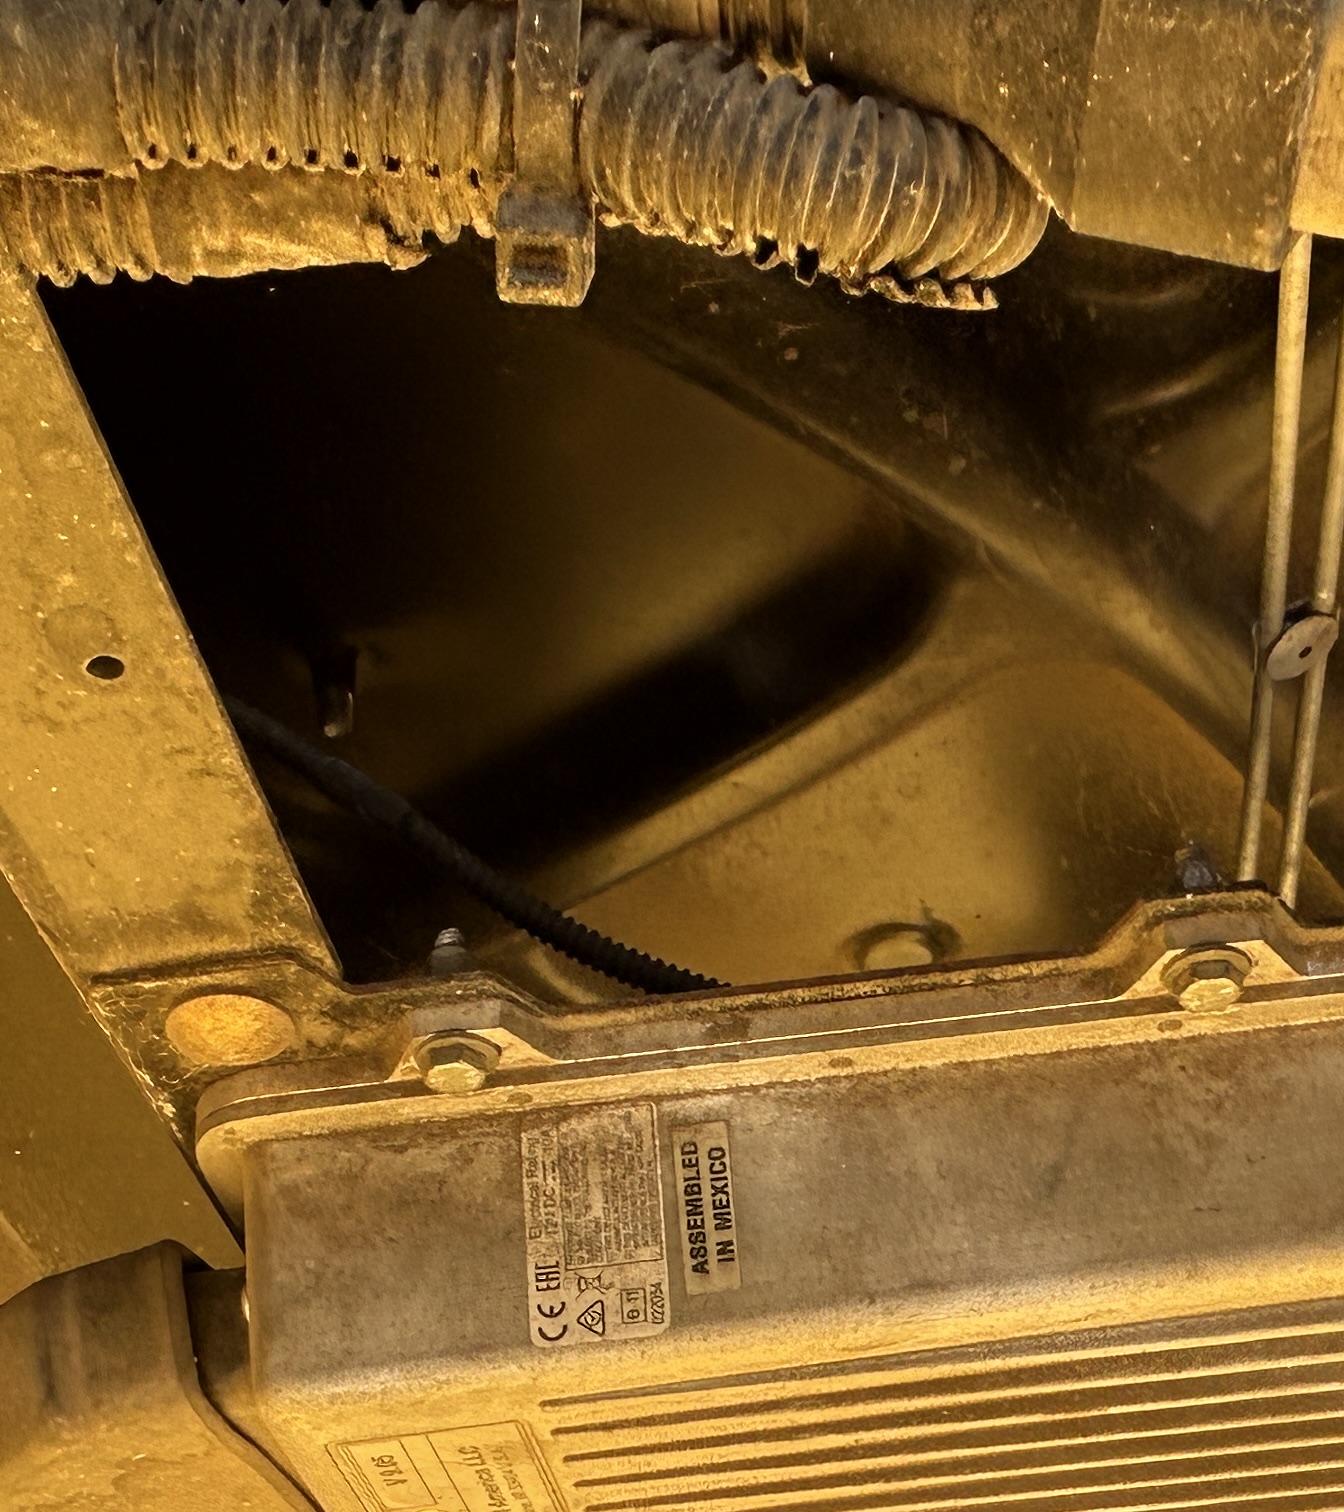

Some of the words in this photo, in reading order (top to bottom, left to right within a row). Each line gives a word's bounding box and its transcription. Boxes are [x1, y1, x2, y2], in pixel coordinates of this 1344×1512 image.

[680, 1140, 710, 1275] ASSEMBLED
[707, 1146, 734, 1232] MEXICO
[716, 1240, 735, 1264] IN
